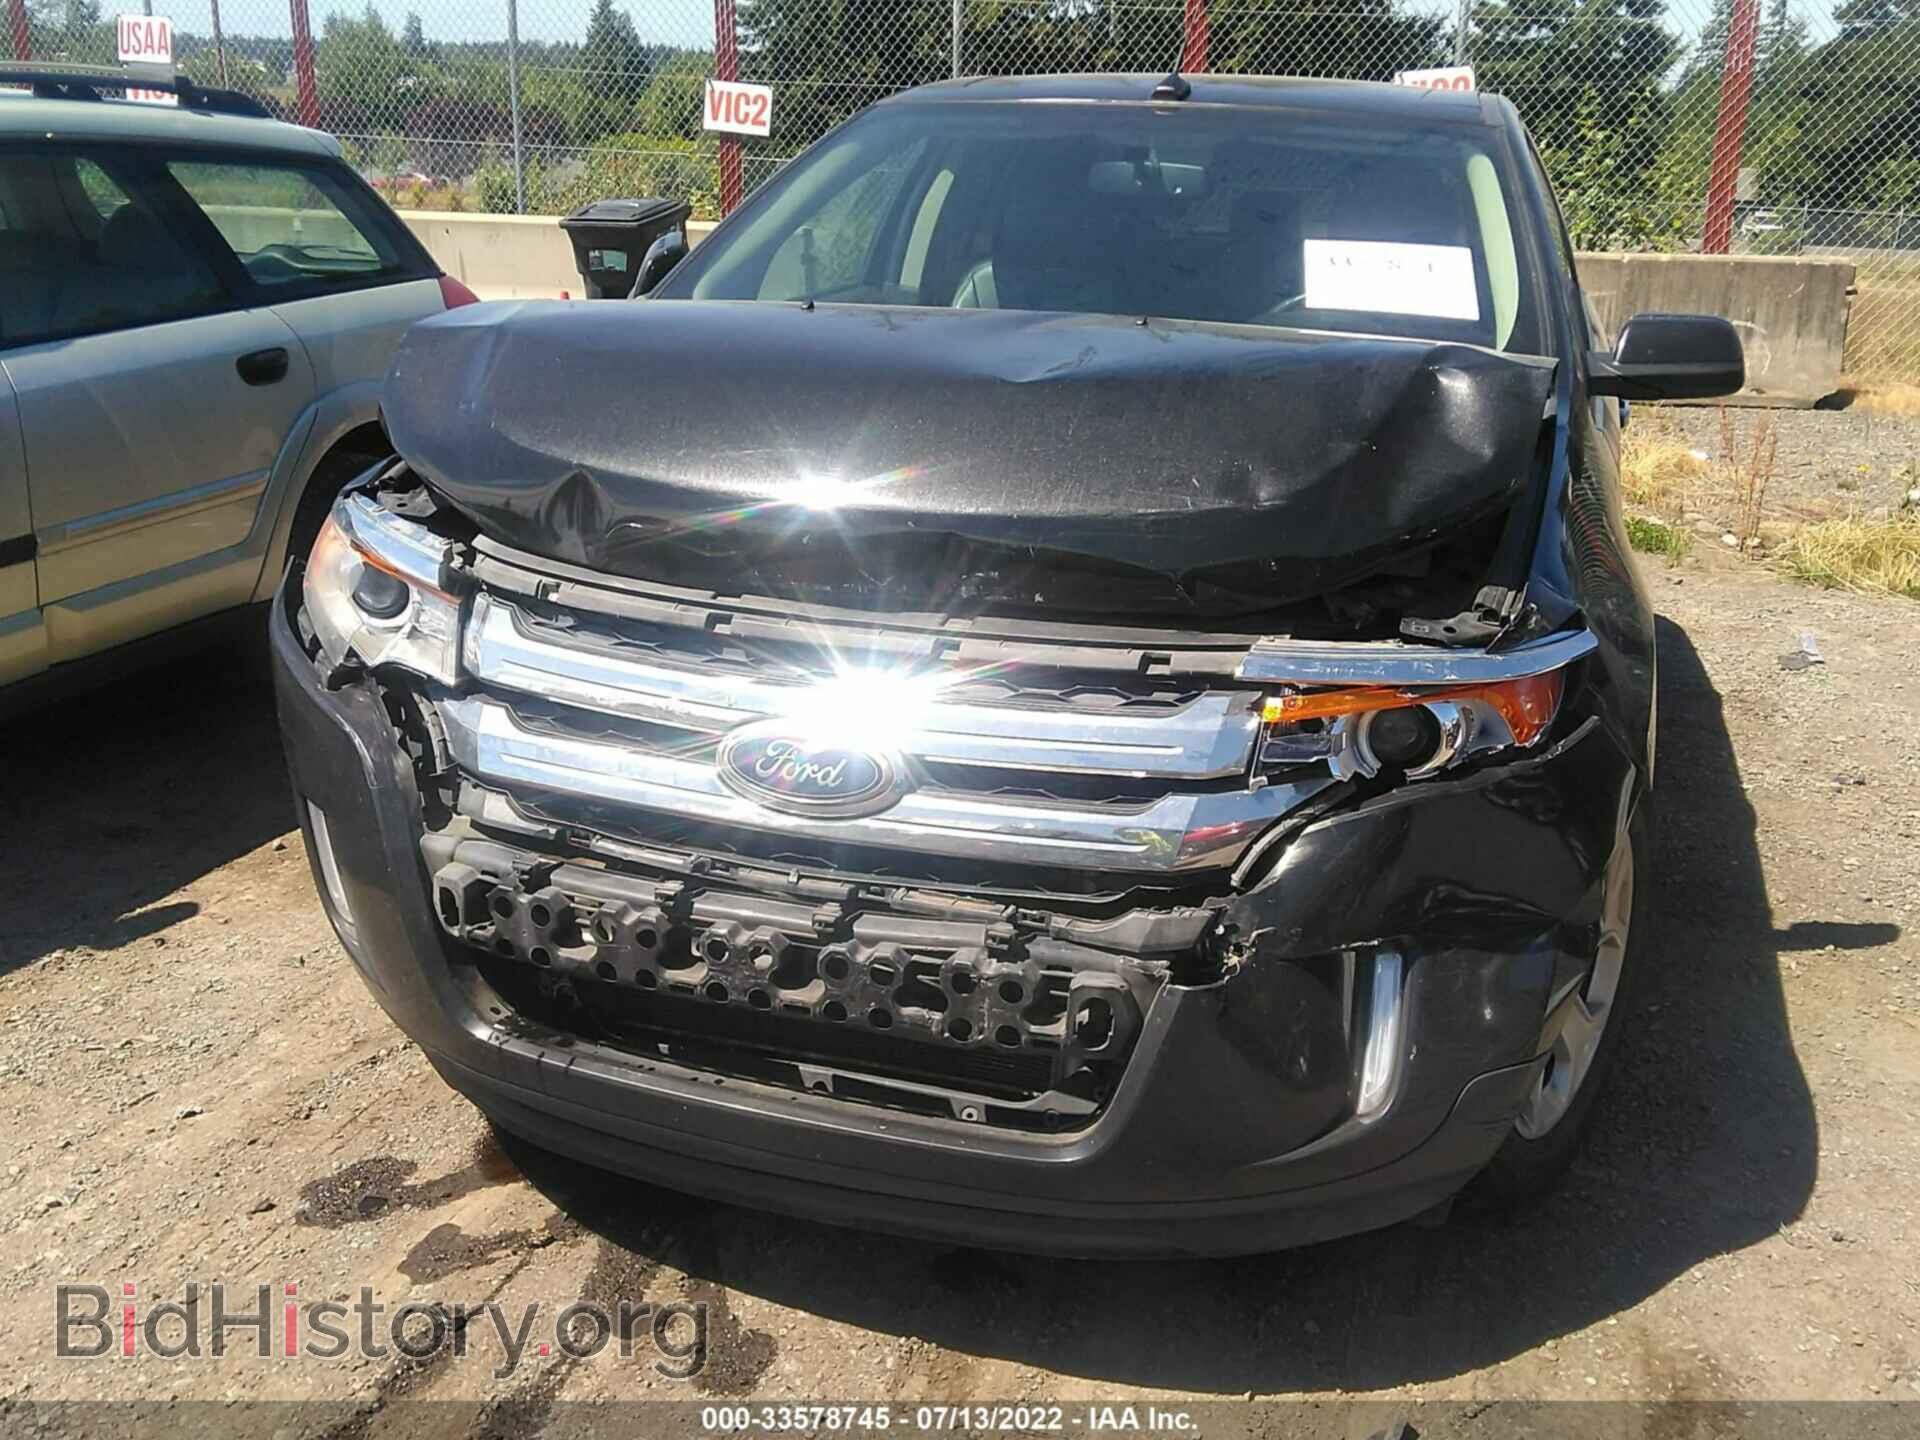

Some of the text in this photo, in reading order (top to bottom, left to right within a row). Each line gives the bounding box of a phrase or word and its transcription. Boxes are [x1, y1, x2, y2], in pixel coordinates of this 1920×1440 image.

[120, 21, 169, 55] USAA
[710, 90, 768, 127] VIC2
[755, 739, 848, 787] Ford
